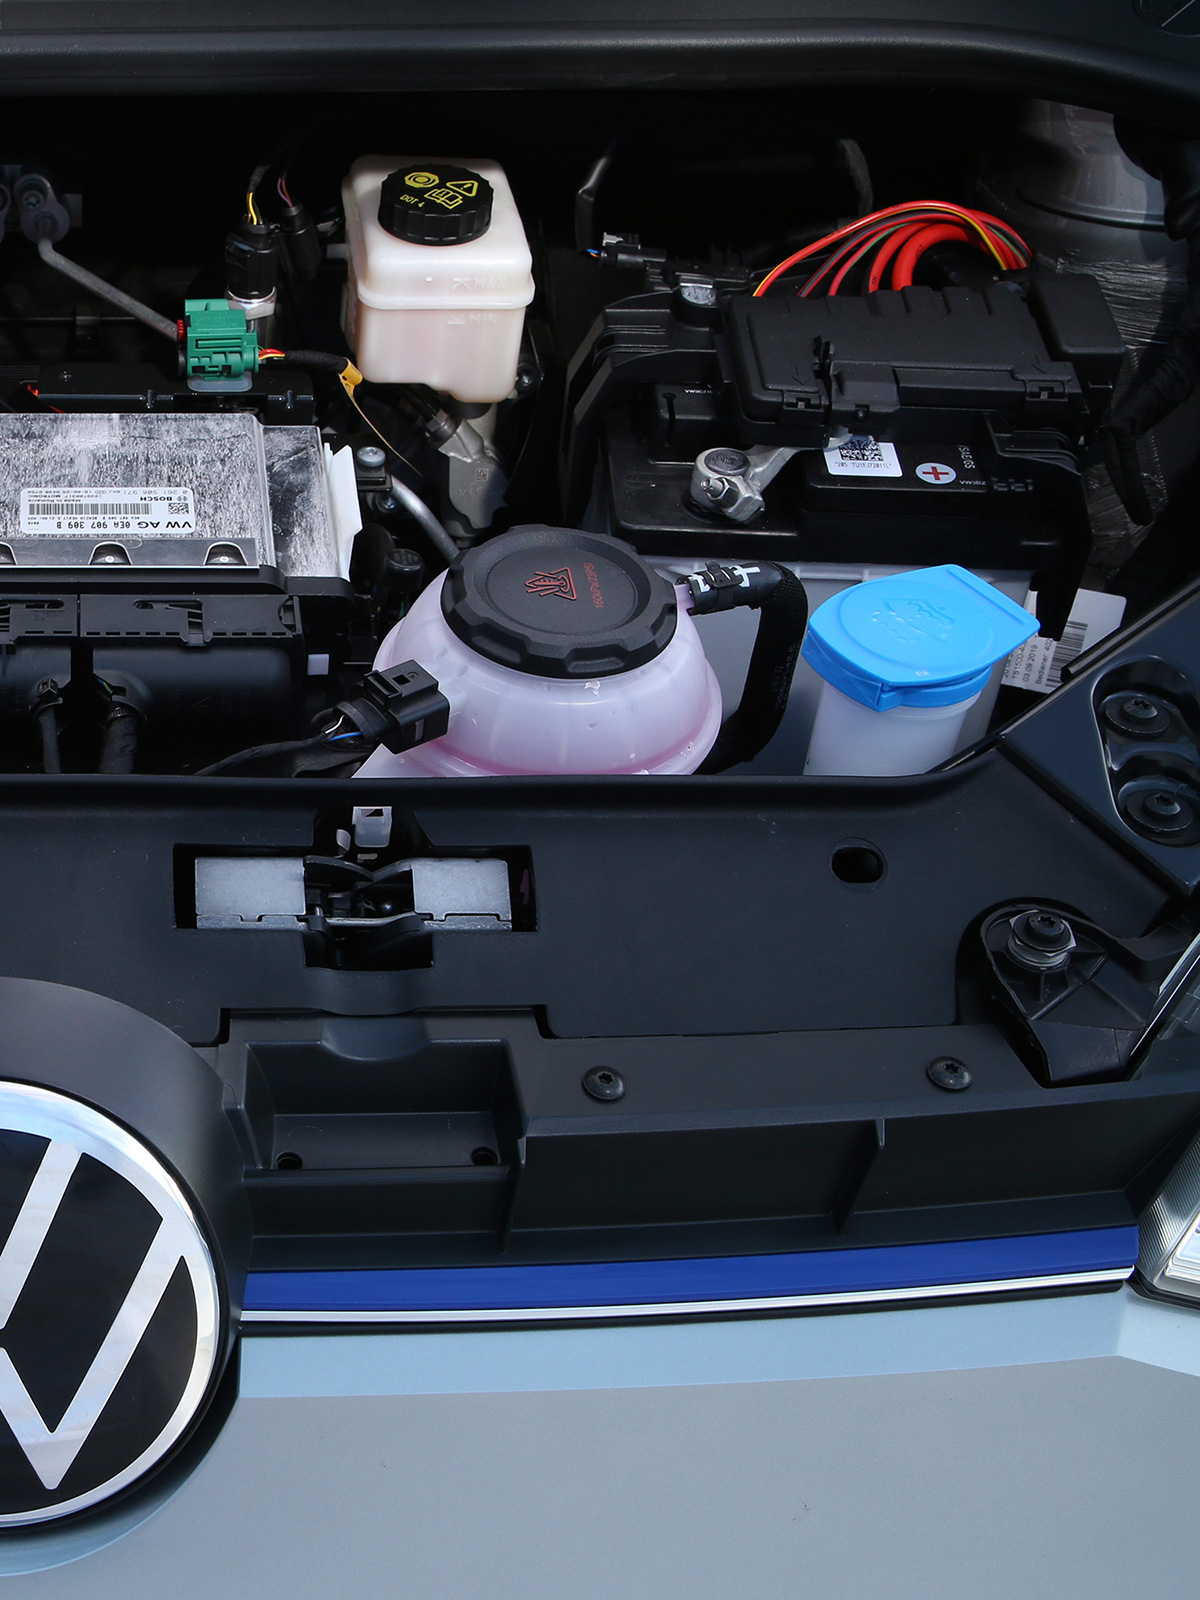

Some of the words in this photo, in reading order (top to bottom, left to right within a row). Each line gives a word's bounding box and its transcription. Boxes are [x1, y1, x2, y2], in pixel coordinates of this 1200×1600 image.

[400, 194, 418, 205] DOT
[56, 521, 62, 529] B
[68, 521, 85, 529] 309
[90, 521, 108, 529] 907
[137, 521, 161, 529] AG
[165, 521, 192, 529] VW
